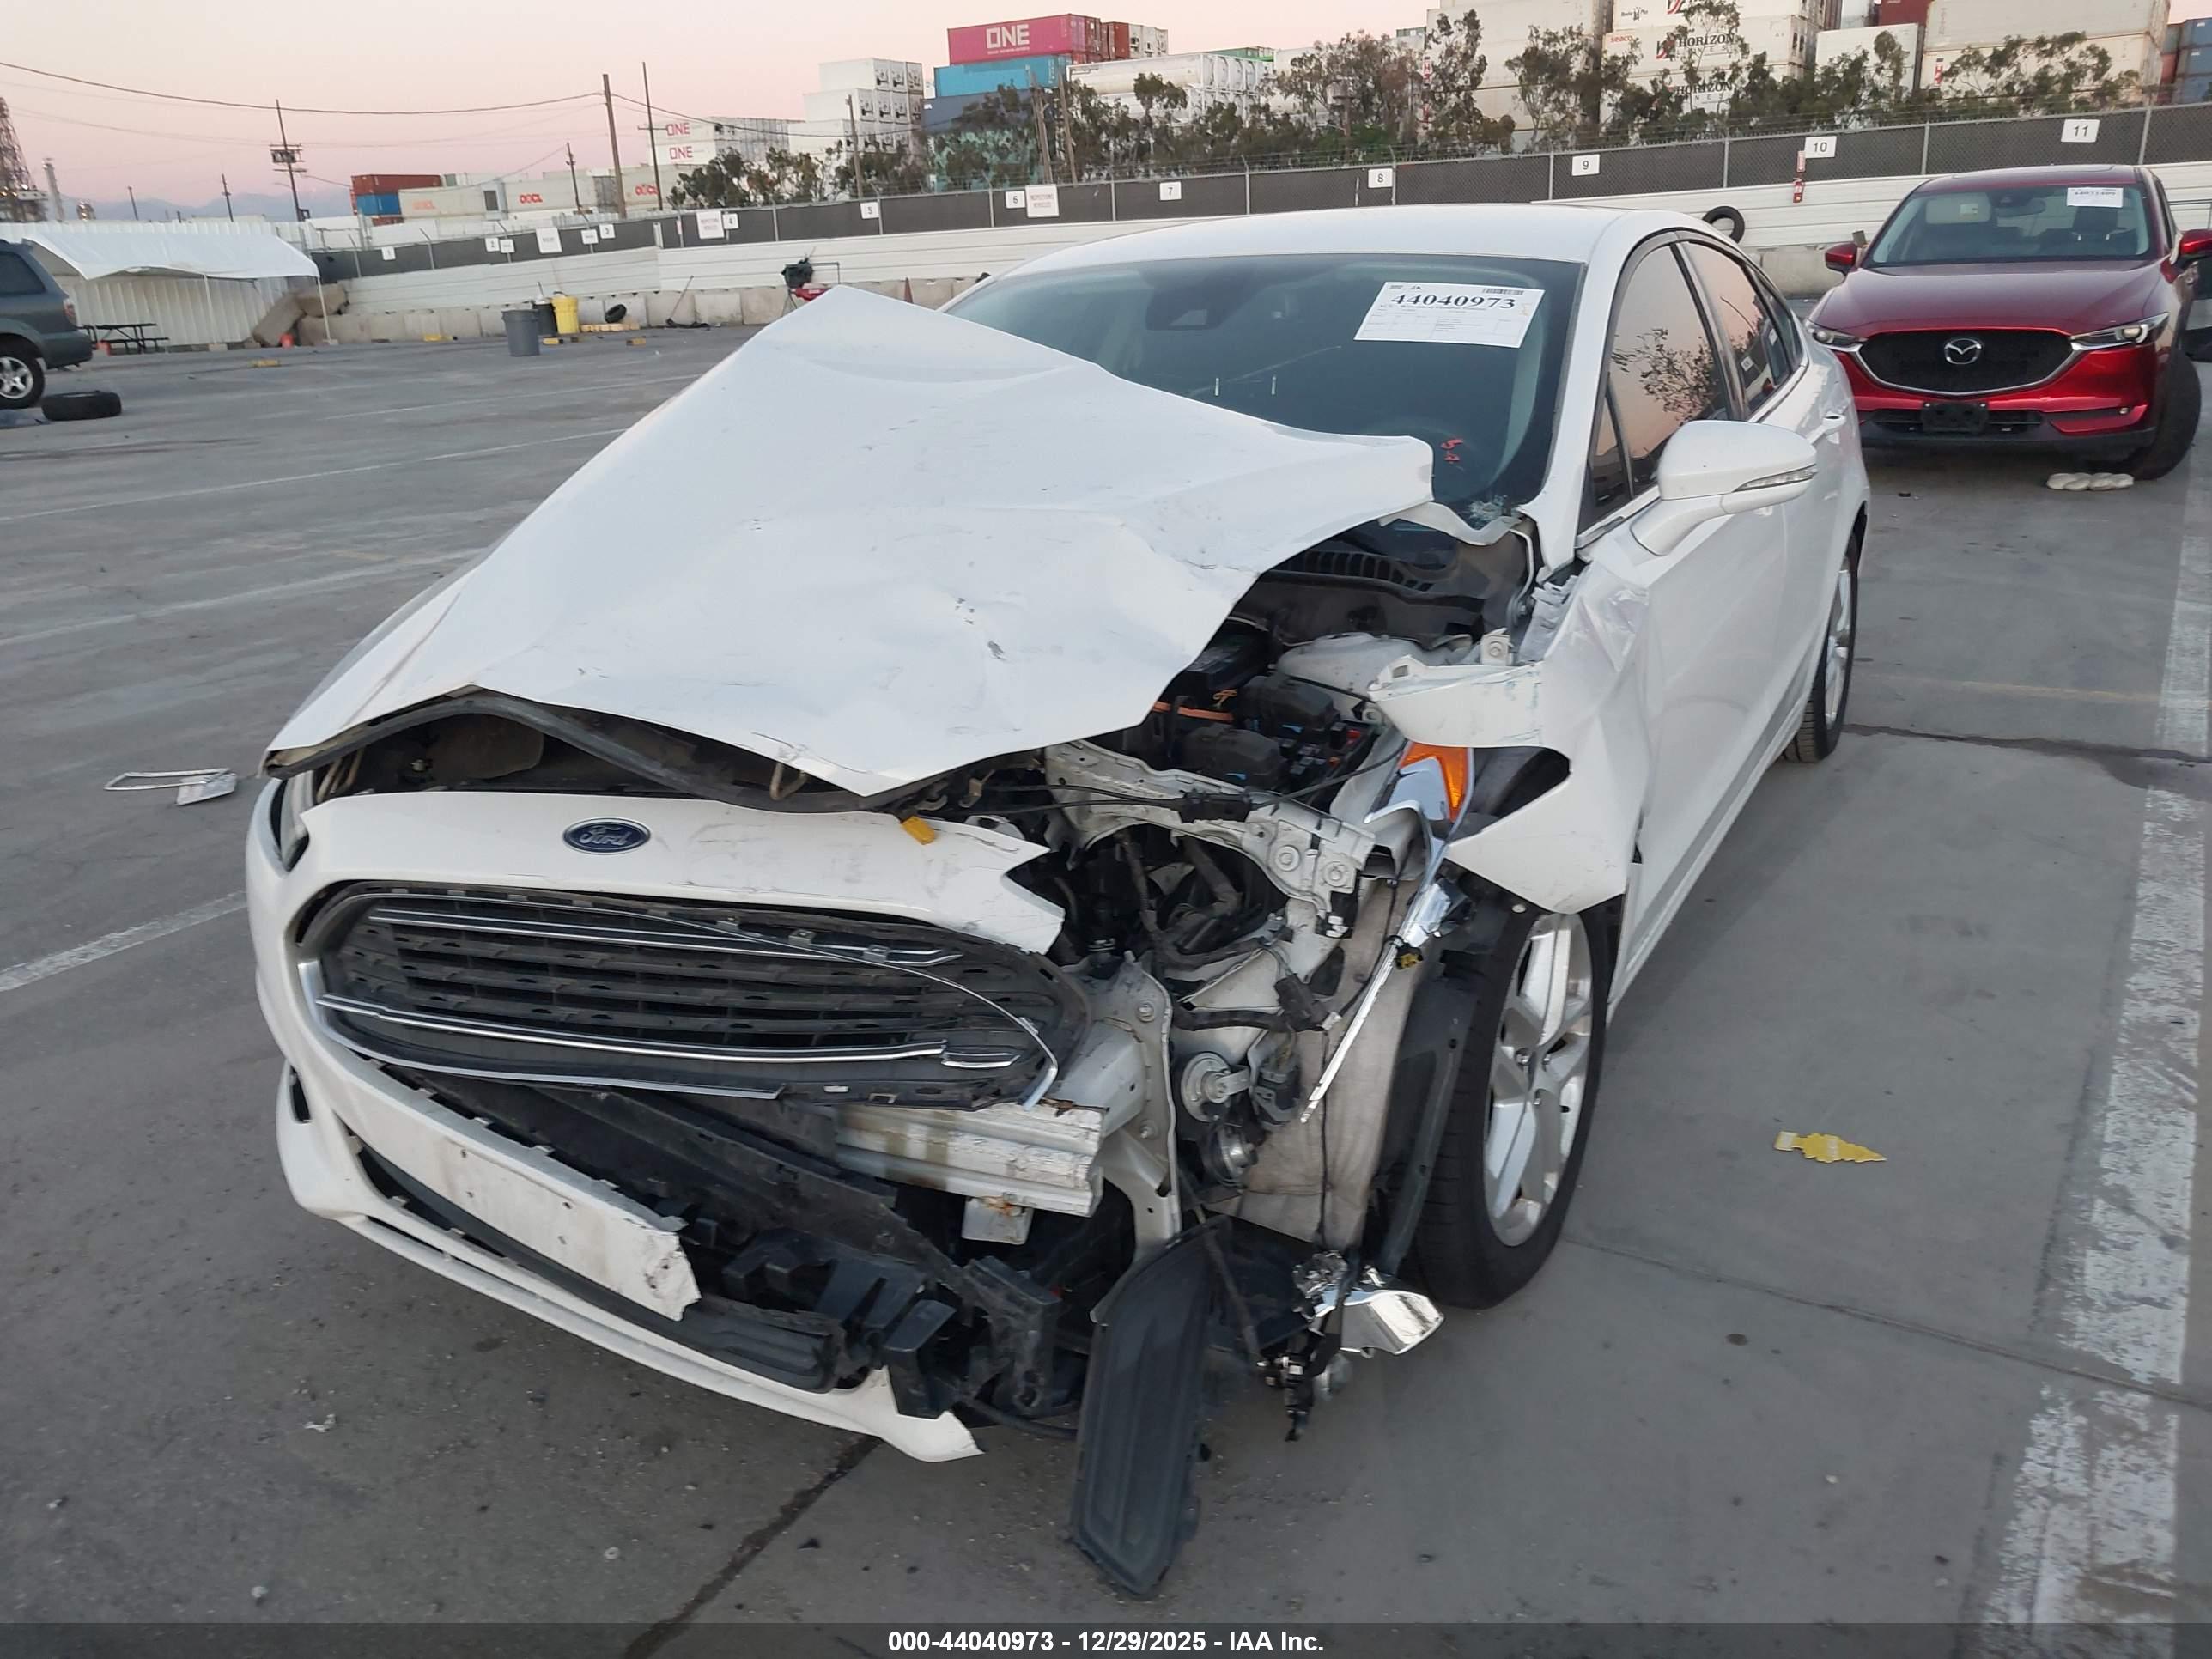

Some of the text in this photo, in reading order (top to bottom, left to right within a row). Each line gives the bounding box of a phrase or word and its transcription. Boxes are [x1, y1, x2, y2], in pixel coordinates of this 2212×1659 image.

[987, 24, 1030, 48] ONE
[1679, 34, 1734, 47] HORIZON
[666, 122, 690, 136] ONE
[2074, 125, 2088, 137] 11
[669, 146, 694, 159] ONE
[1814, 142, 1827, 152] 10
[1583, 160, 1589, 170] 9
[1377, 173, 1383, 183] 8
[1168, 186, 1173, 196] 7
[1012, 195, 1018, 204] 6
[1391, 294, 1516, 309] 44040973
[580, 825, 631, 846] Ford
